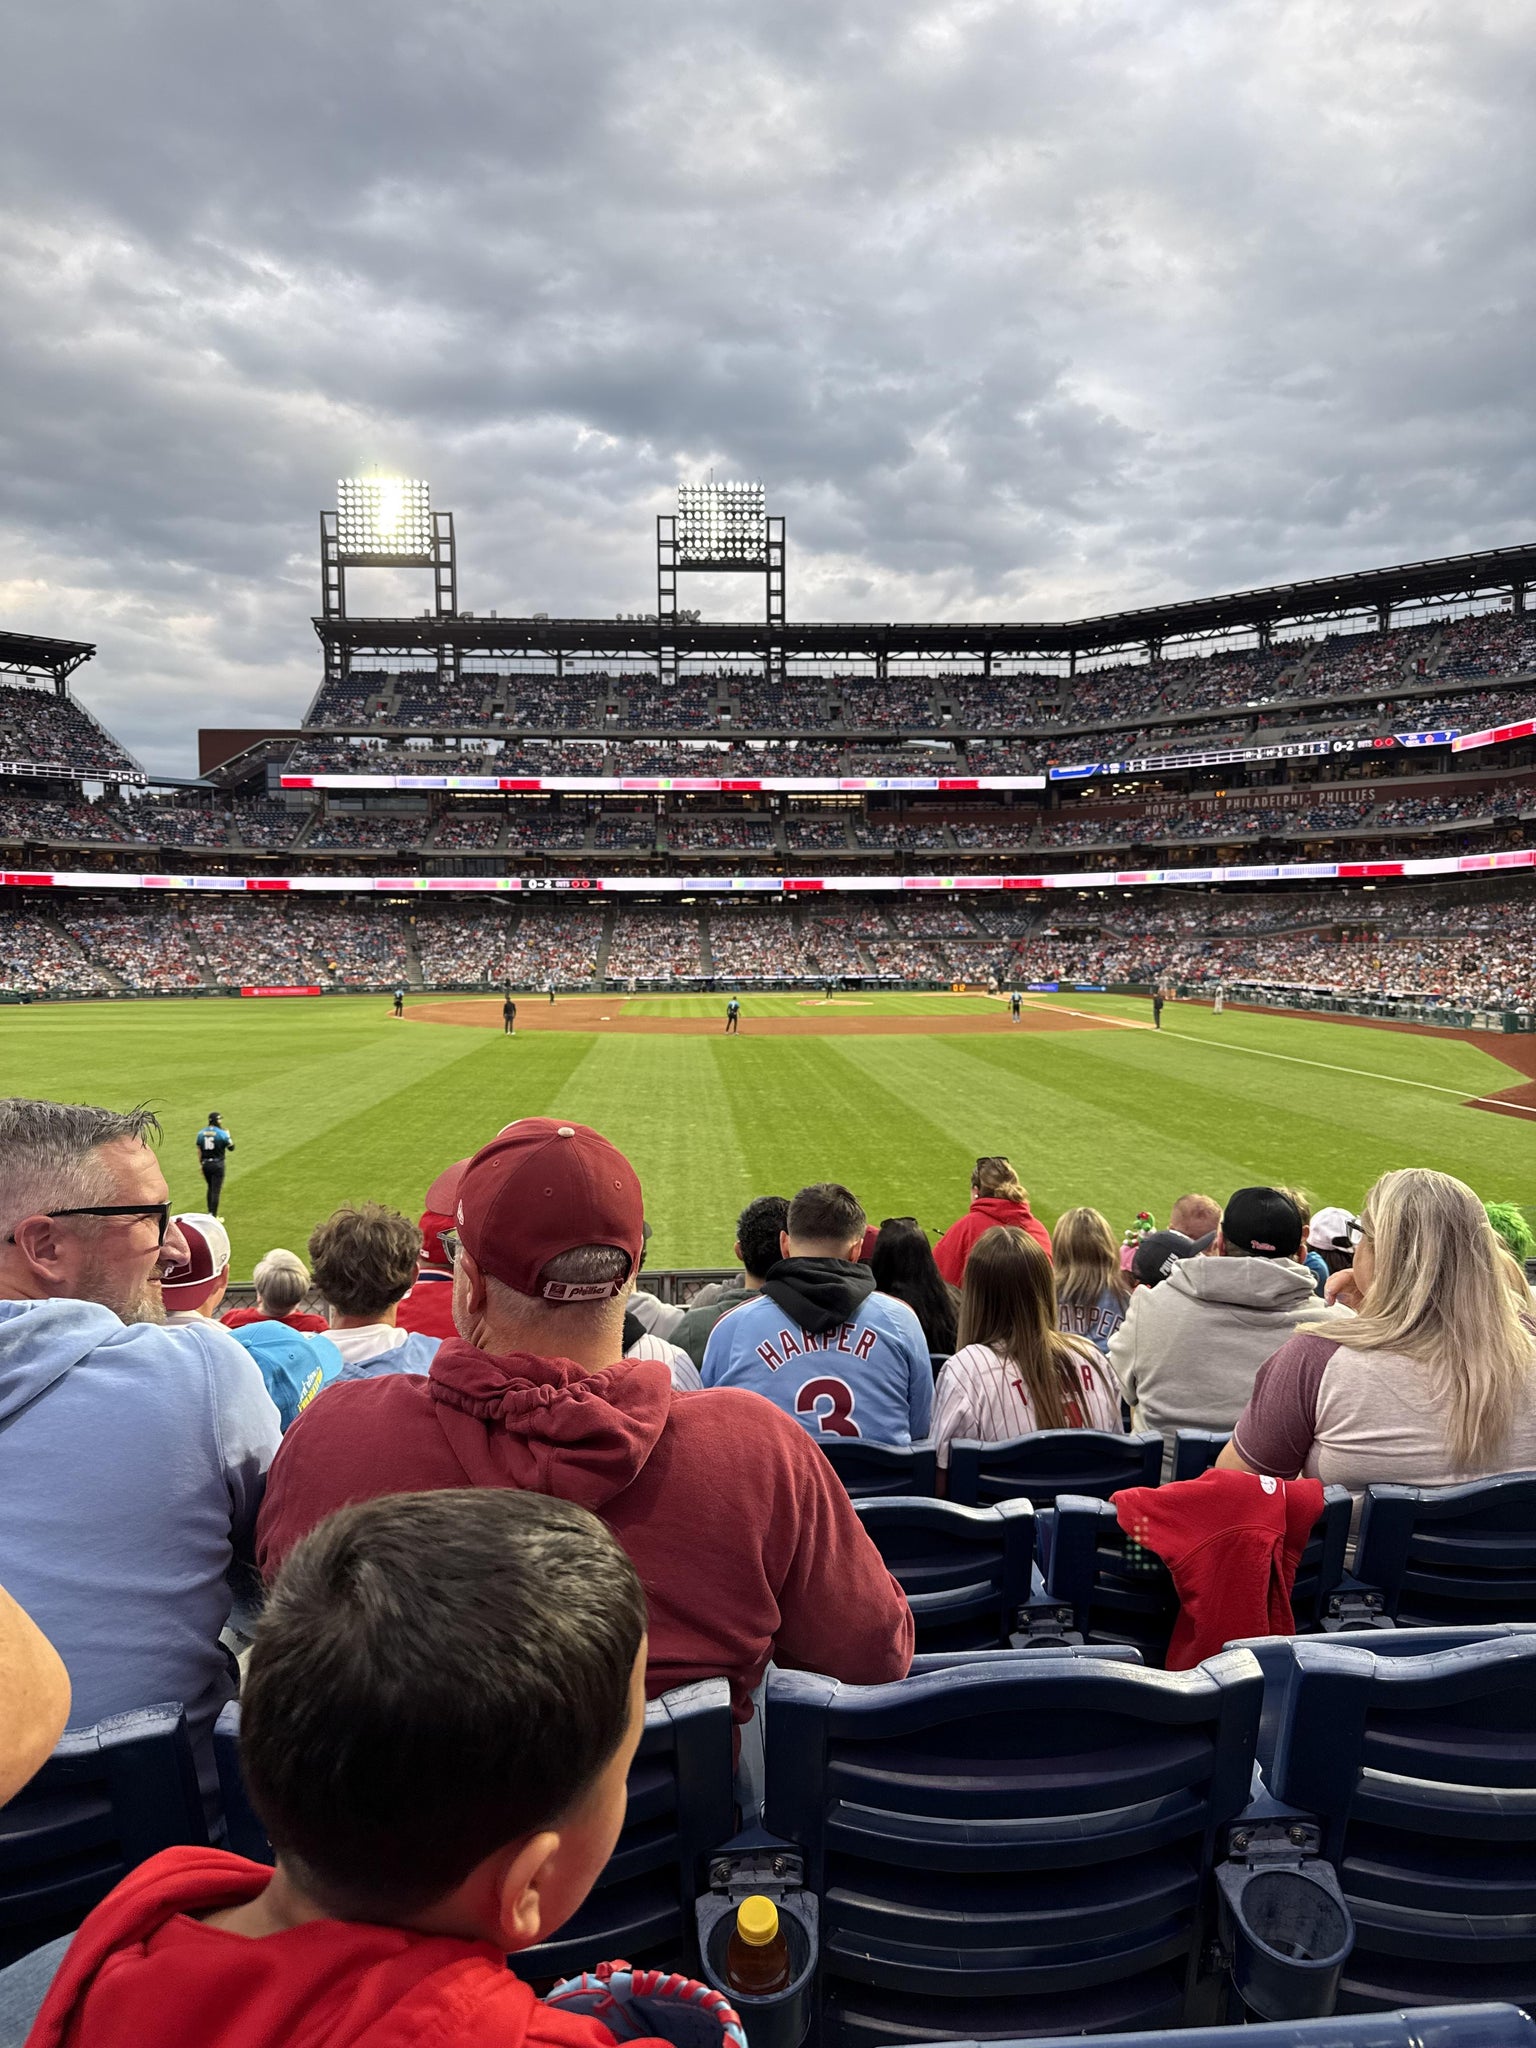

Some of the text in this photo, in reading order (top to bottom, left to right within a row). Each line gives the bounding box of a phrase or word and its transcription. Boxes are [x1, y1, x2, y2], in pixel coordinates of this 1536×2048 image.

[1444, 732, 1452, 740] 7
[1333, 739, 1373, 752] 0-2 OUTS
[1145, 803, 1175, 816] HOME
[1200, 800, 1219, 812] THE
[1319, 788, 1375, 804] PHILLIES
[528, 879, 552, 889] 0-2
[204, 1136, 215, 1150] 16
[755, 1322, 878, 1372] HARPER
[795, 1375, 862, 1438] 3
